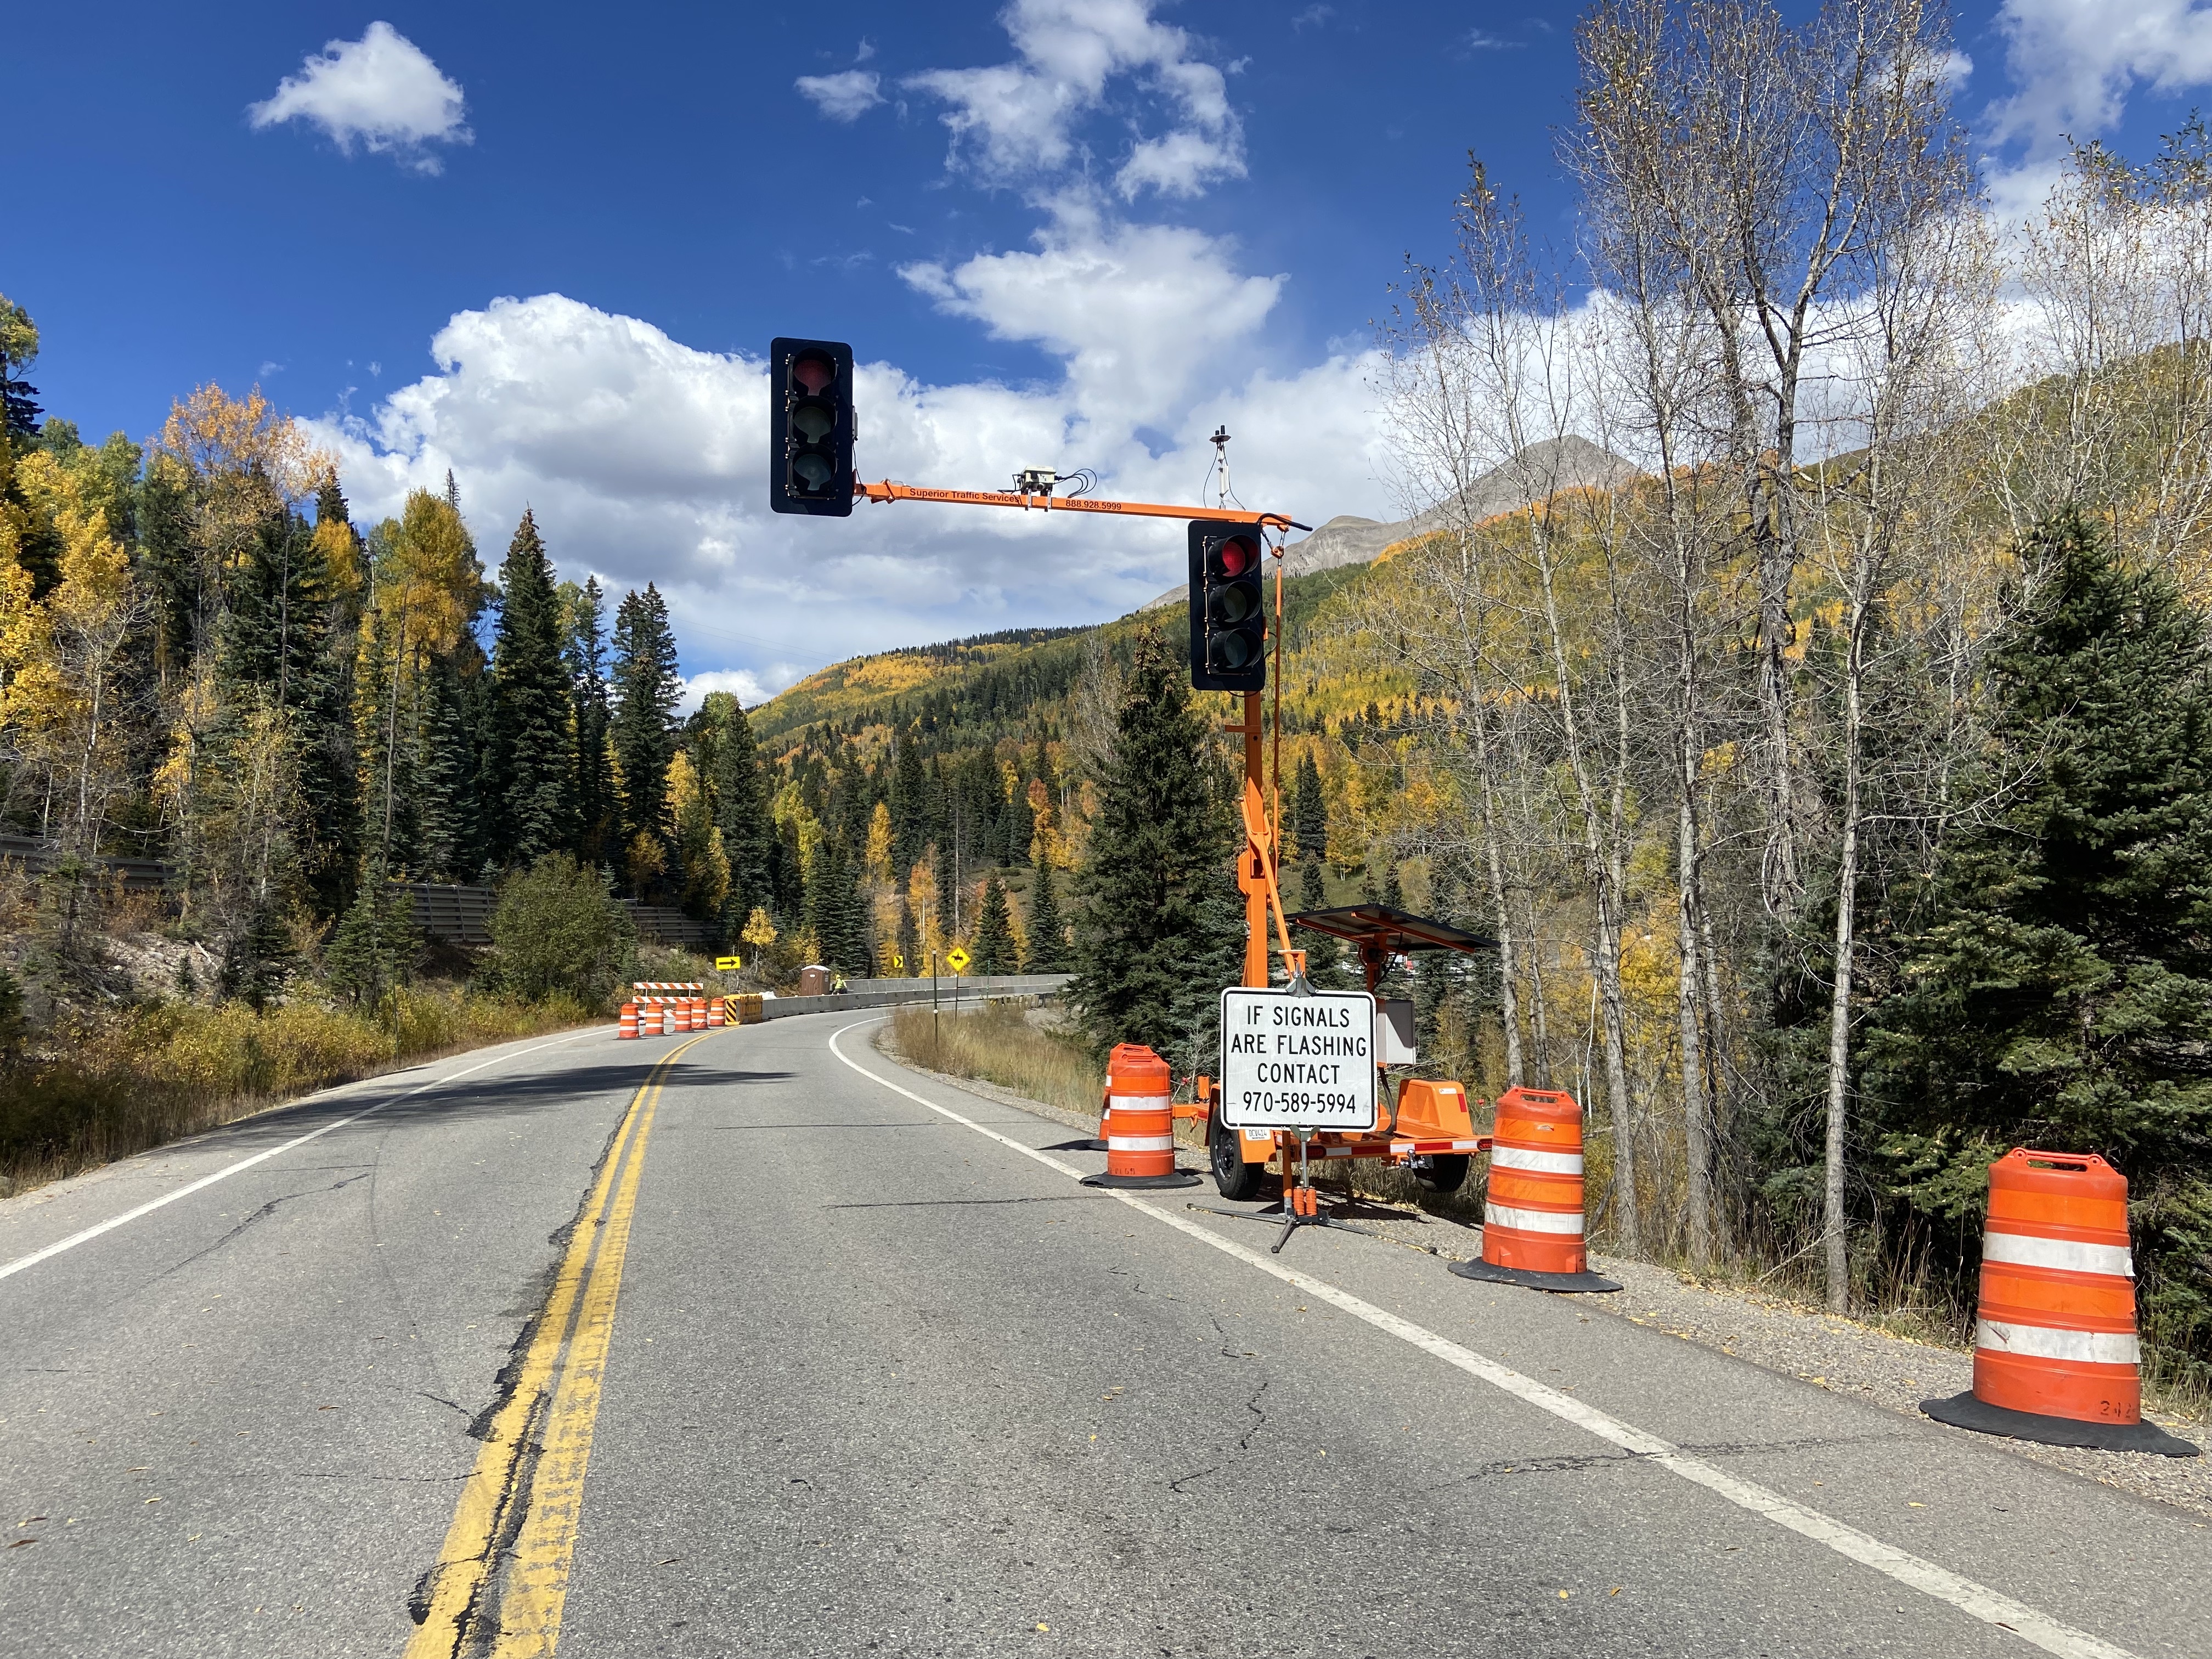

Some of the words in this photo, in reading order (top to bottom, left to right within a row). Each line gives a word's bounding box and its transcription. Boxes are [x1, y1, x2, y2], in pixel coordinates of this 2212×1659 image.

[910, 488, 949, 498] Superior
[951, 490, 980, 499] Traffic
[982, 492, 1019, 503] Services
[1066, 500, 1121, 510] 888.928.5999
[1247, 1005, 1263, 1025] IF
[1273, 1006, 1350, 1028] SIGNALS
[1231, 1033, 1267, 1054] ARE
[1277, 1035, 1367, 1057] FLASHING
[1257, 1063, 1340, 1084] CONTACT
[1243, 1091, 1356, 1114] 970-589-5994
